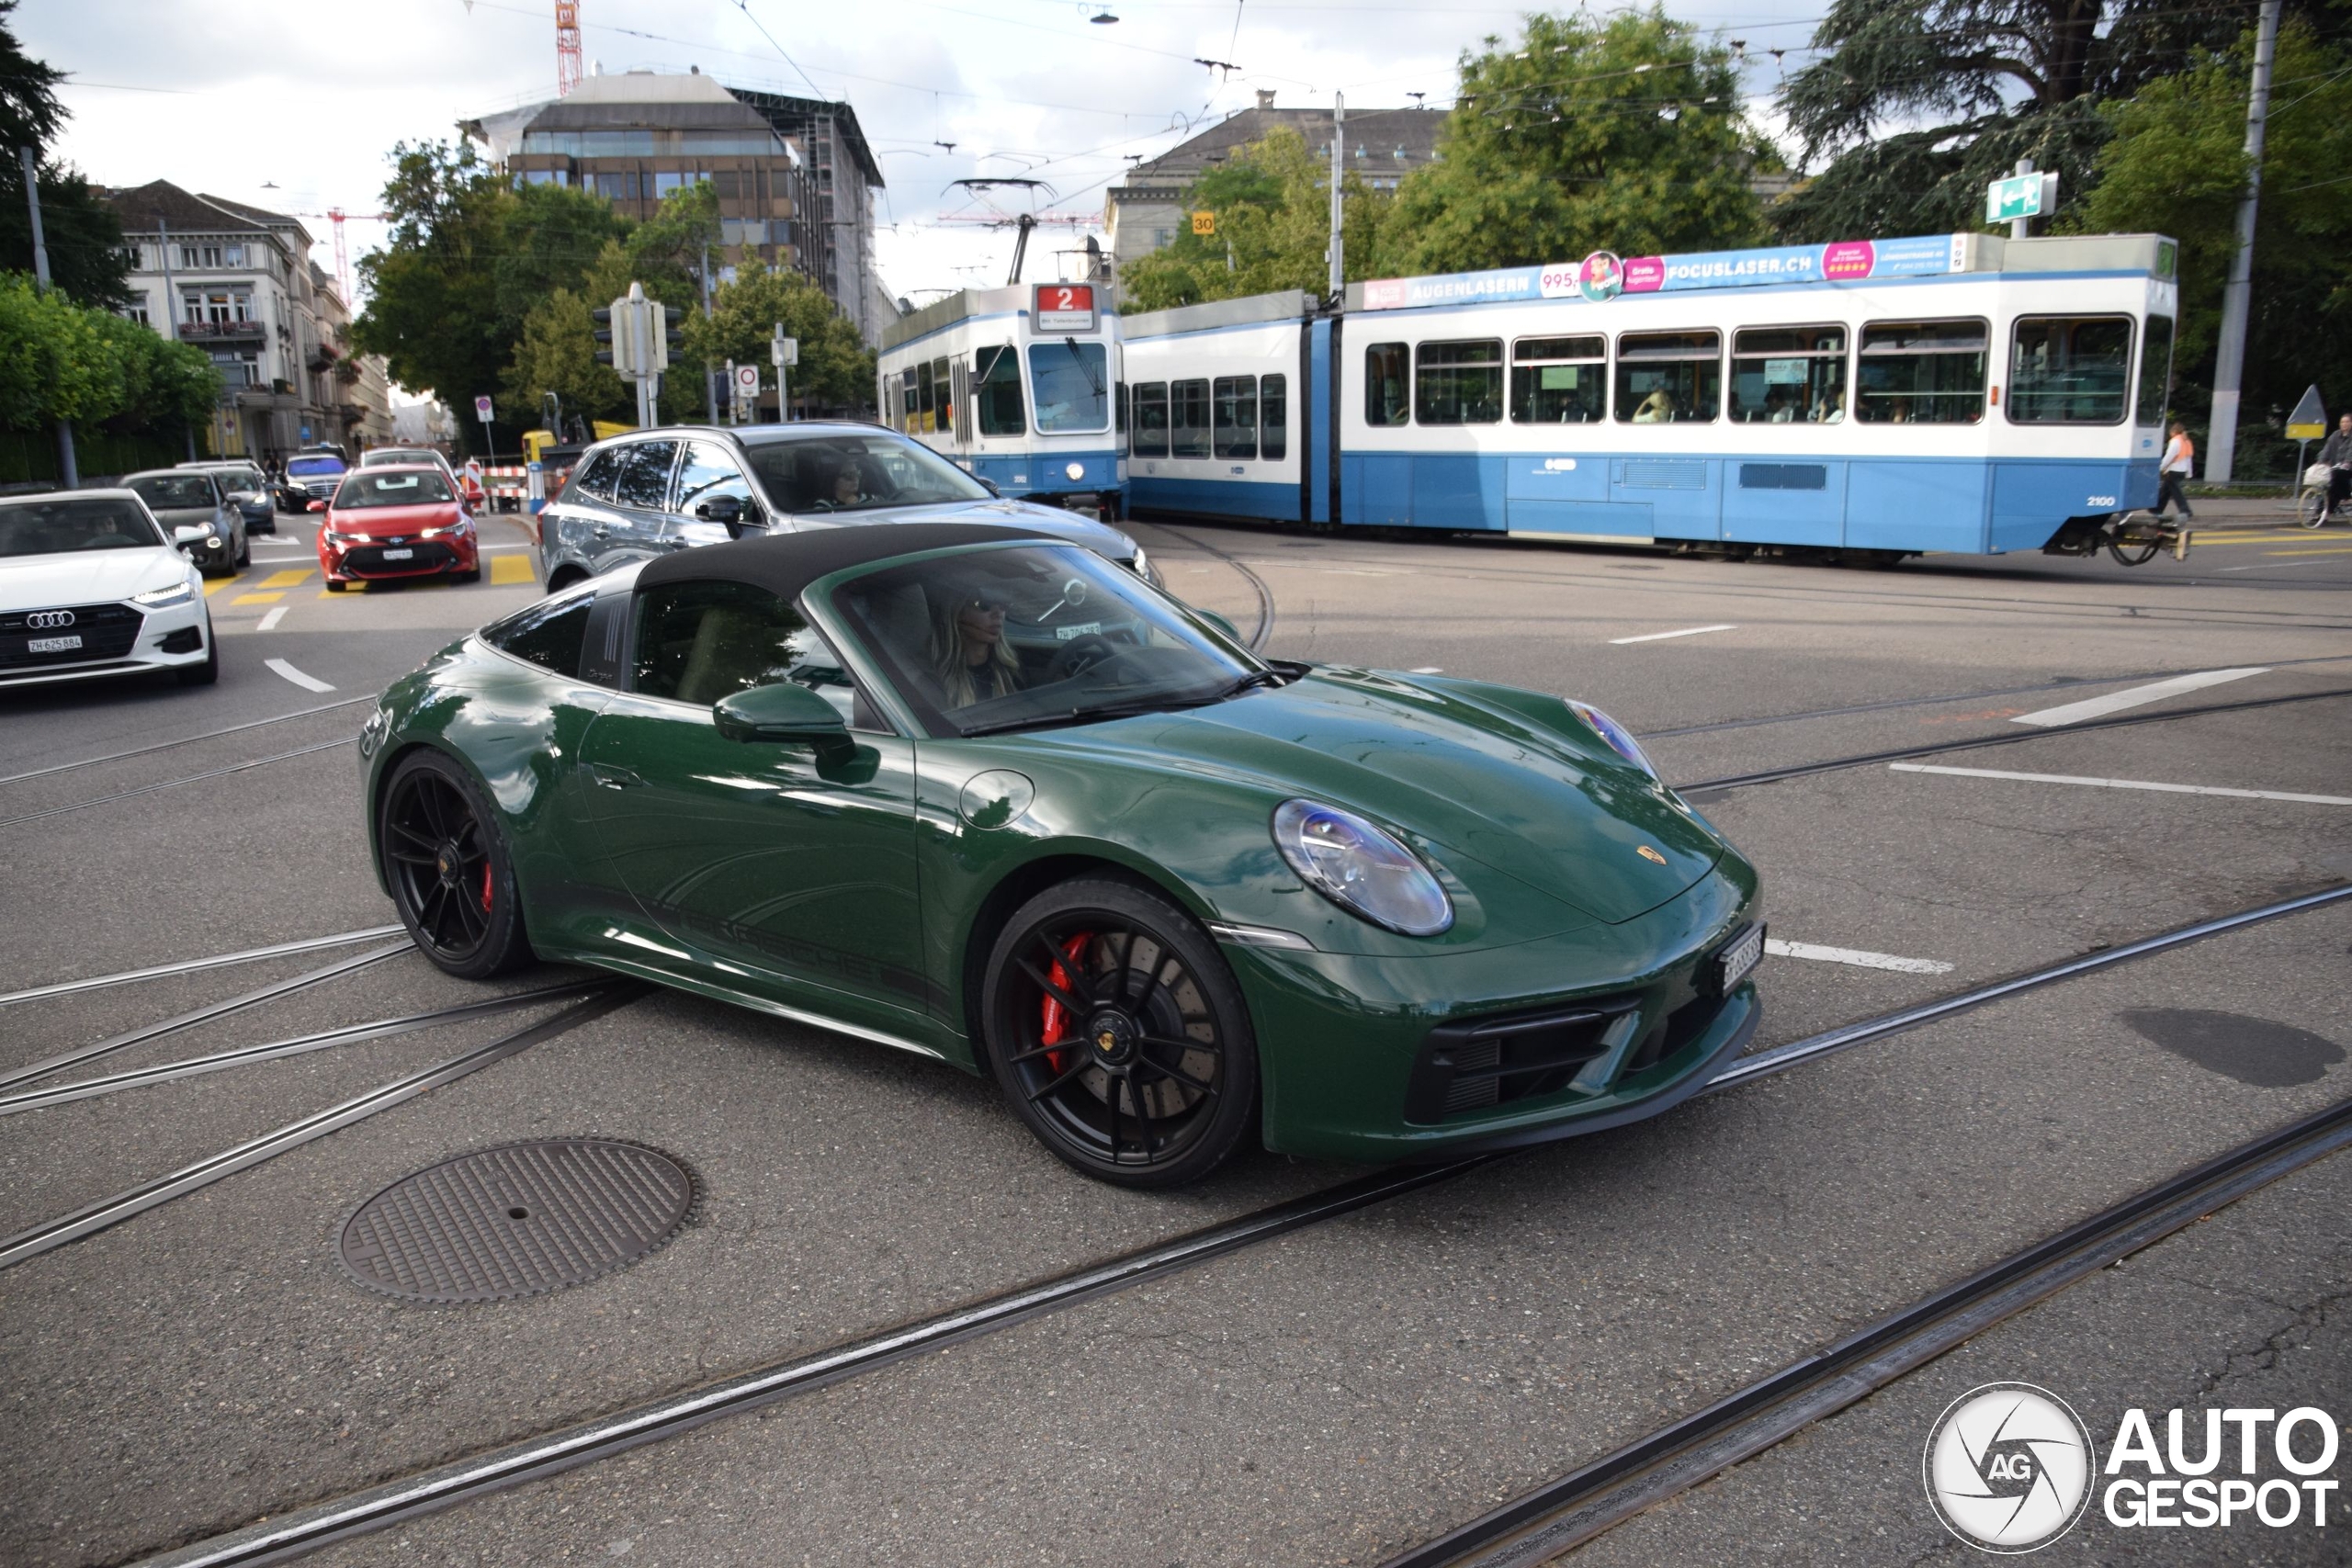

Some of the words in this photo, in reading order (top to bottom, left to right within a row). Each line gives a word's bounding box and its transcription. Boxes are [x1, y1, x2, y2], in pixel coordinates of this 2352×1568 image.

[1194, 219, 1213, 231] 30
[1668, 256, 1812, 279] FOCUSLASER.CH
[1057, 288, 1074, 310] 2
[1411, 276, 1529, 300] AUGENLASERN
[2086, 496, 2116, 506] 2100
